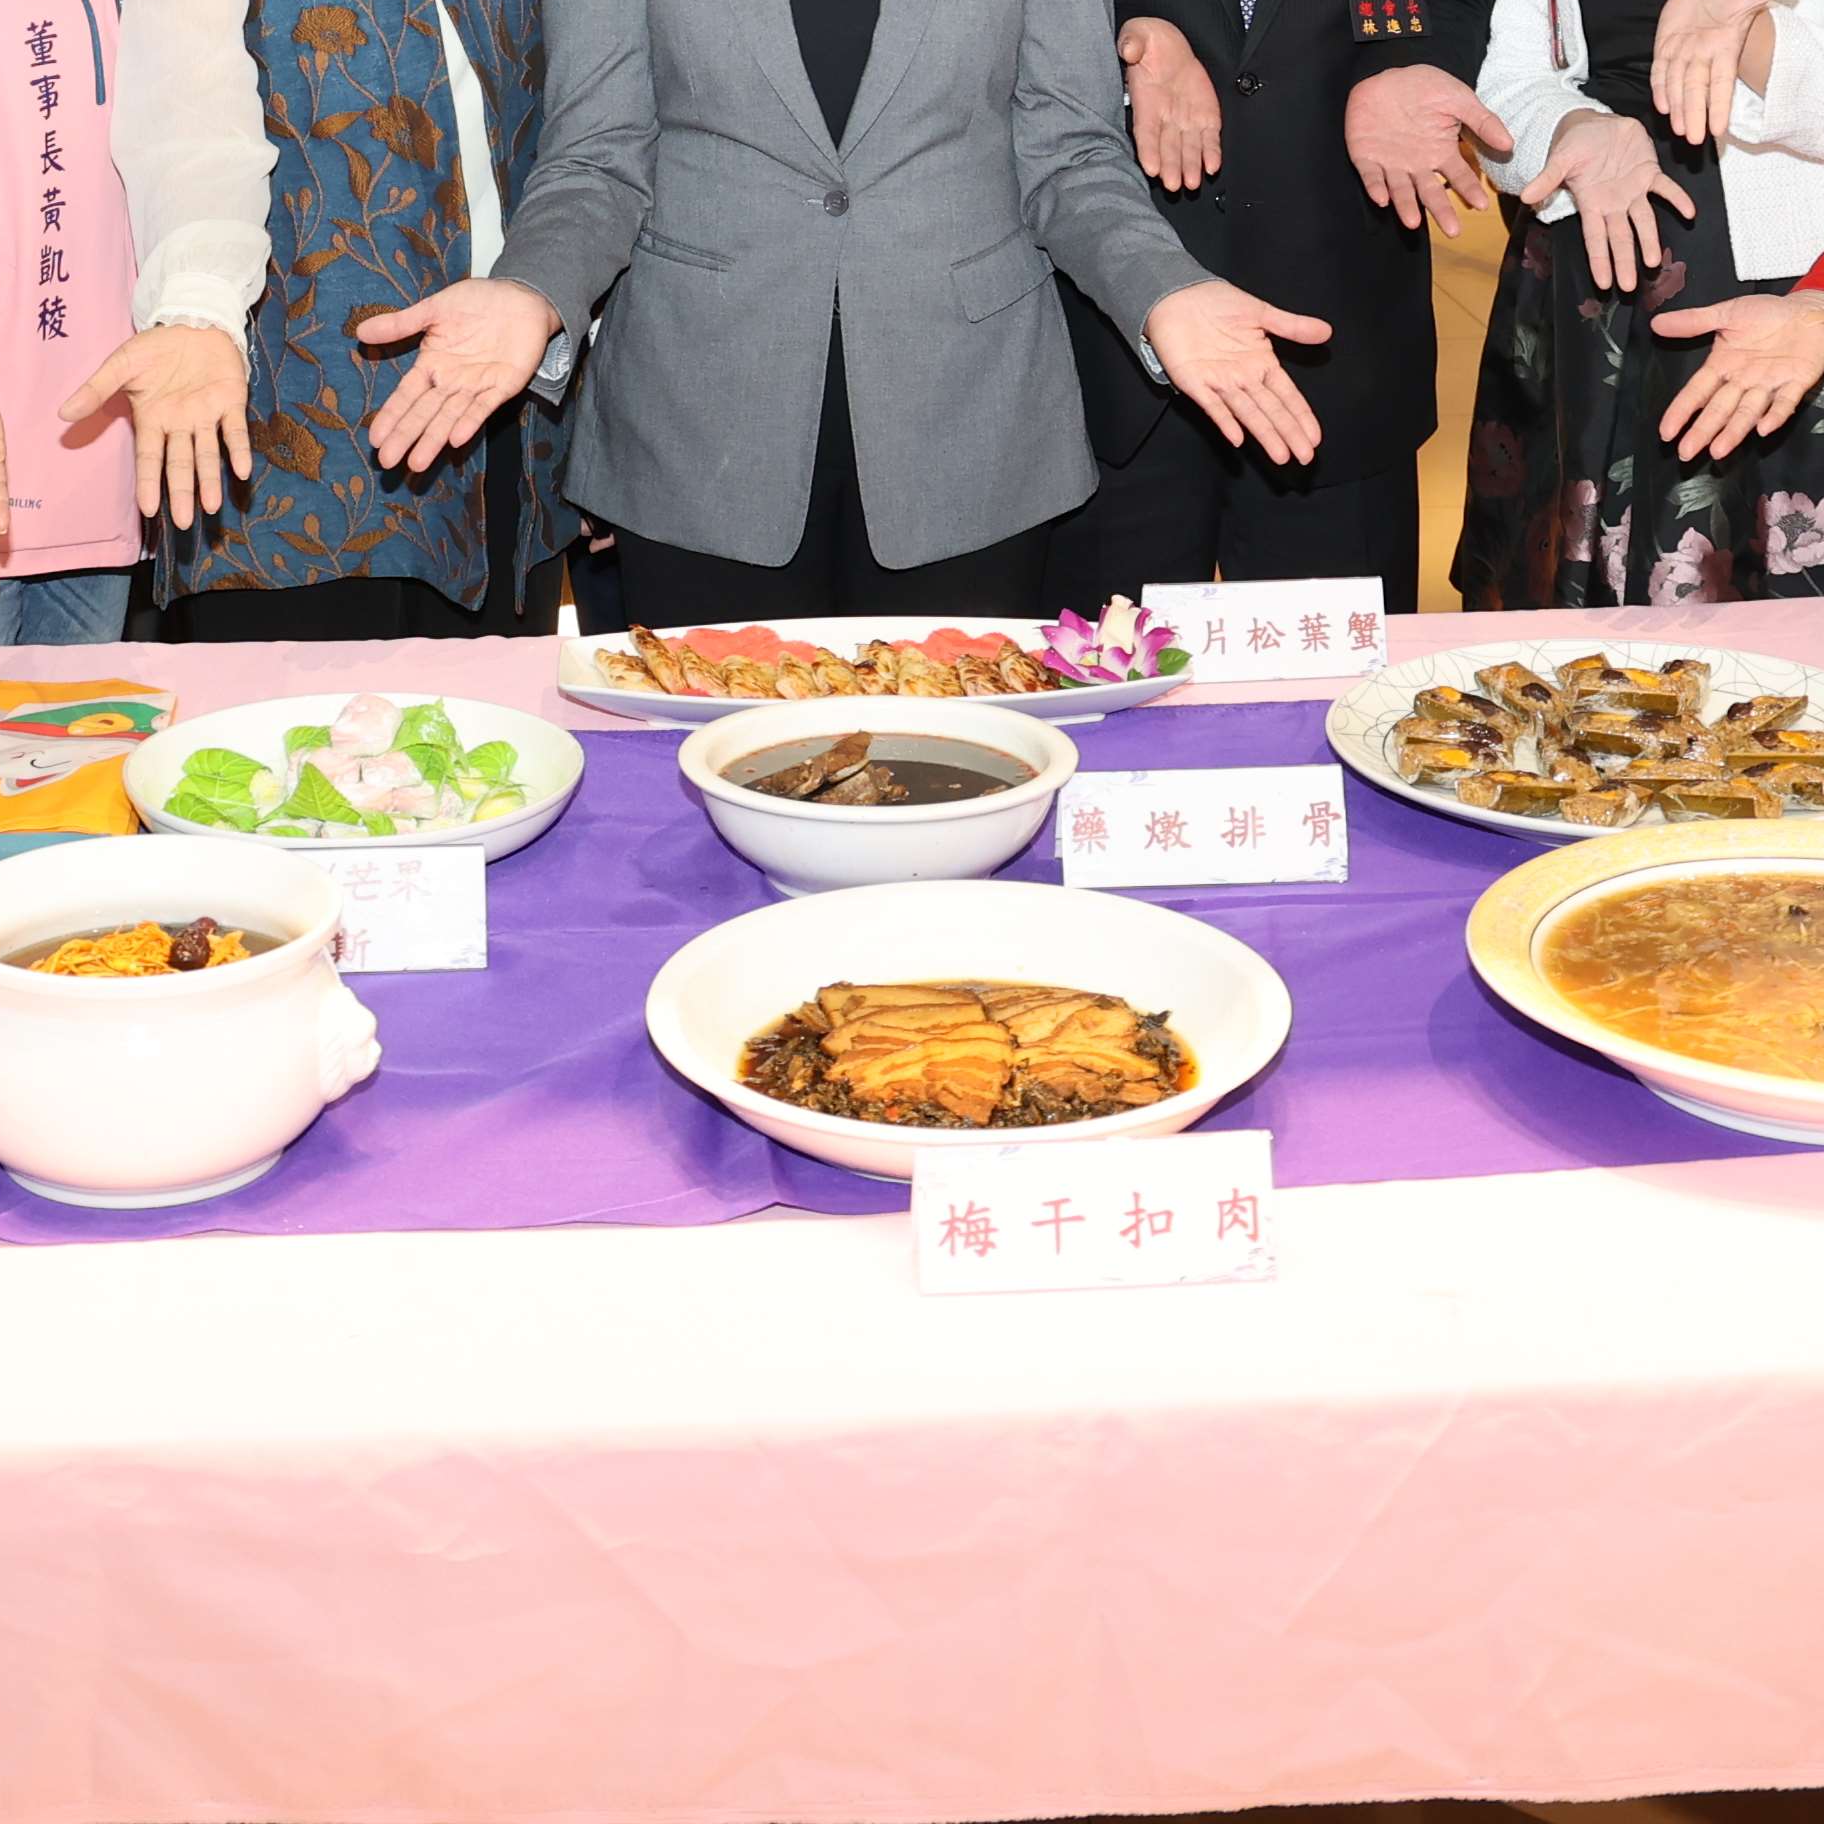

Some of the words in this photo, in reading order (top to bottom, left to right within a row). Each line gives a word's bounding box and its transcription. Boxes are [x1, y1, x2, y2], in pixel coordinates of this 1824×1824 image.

[1070, 799, 1344, 853] 藥燉排骨
[329, 859, 433, 902] 芒果
[937, 1187, 1263, 1258] 梅干扣肉
